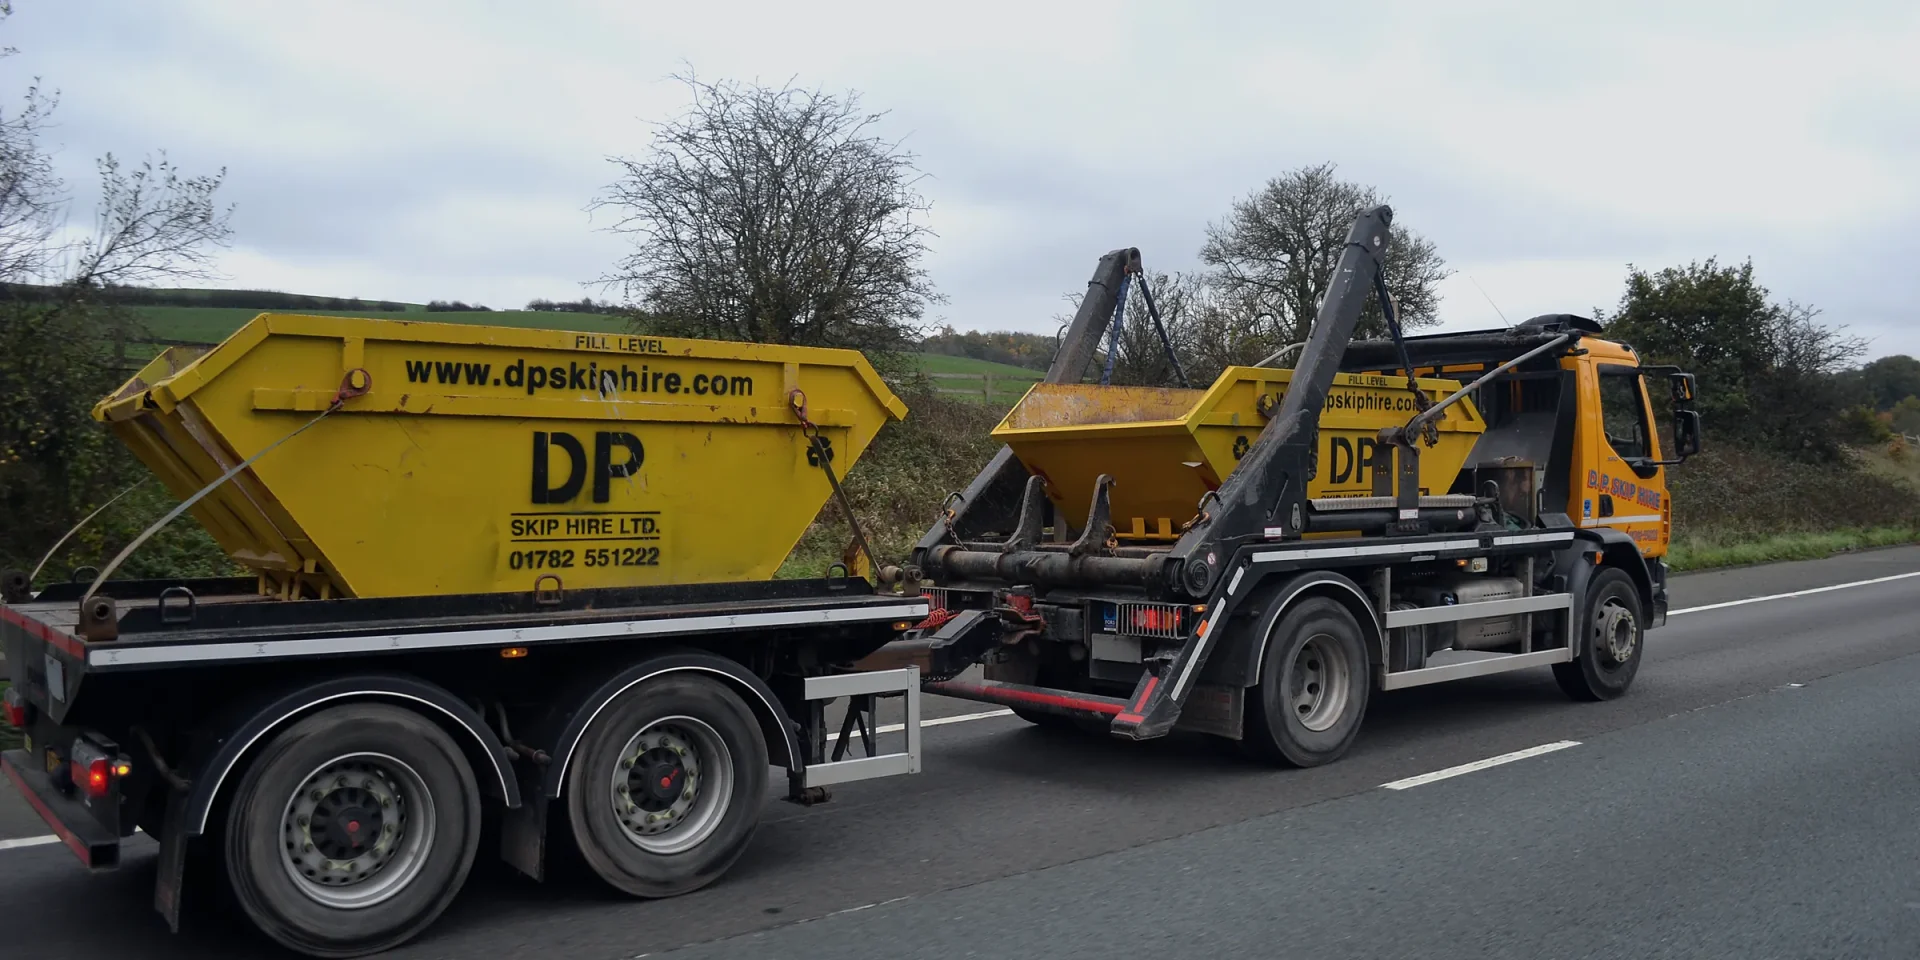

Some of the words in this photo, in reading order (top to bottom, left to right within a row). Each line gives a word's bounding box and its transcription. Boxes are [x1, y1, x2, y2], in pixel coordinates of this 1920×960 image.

[575, 335, 610, 350] FILL
[619, 338, 668, 353] LEVEL
[405, 358, 754, 397] www.dpskiphire.com
[1348, 375, 1363, 385] FILL
[1366, 376, 1388, 386] LEVEL
[531, 431, 645, 504] DP
[1610, 477, 1636, 502] SKIP
[1636, 486, 1661, 511] HIRE
[511, 519, 559, 537] SKIP
[566, 518, 613, 535] HIRE
[620, 517, 661, 535] LTD.
[509, 549, 575, 570] 01782
[584, 547, 660, 568] 551222
